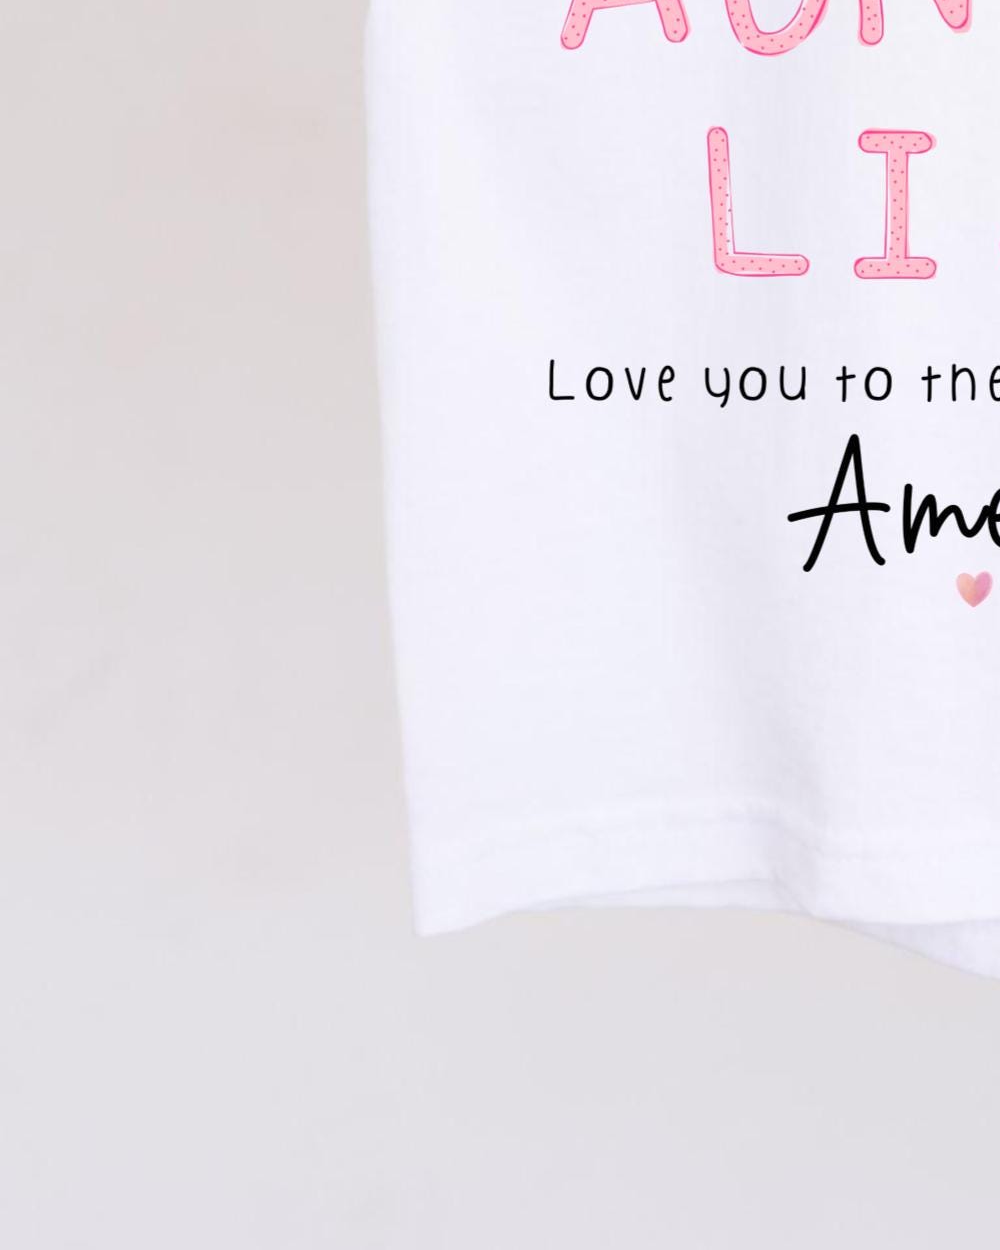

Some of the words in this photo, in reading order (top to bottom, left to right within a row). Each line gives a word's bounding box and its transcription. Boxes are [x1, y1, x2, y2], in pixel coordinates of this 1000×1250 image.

[548, 358, 676, 403] Love
[704, 364, 807, 409] you
[835, 365, 893, 403] to
